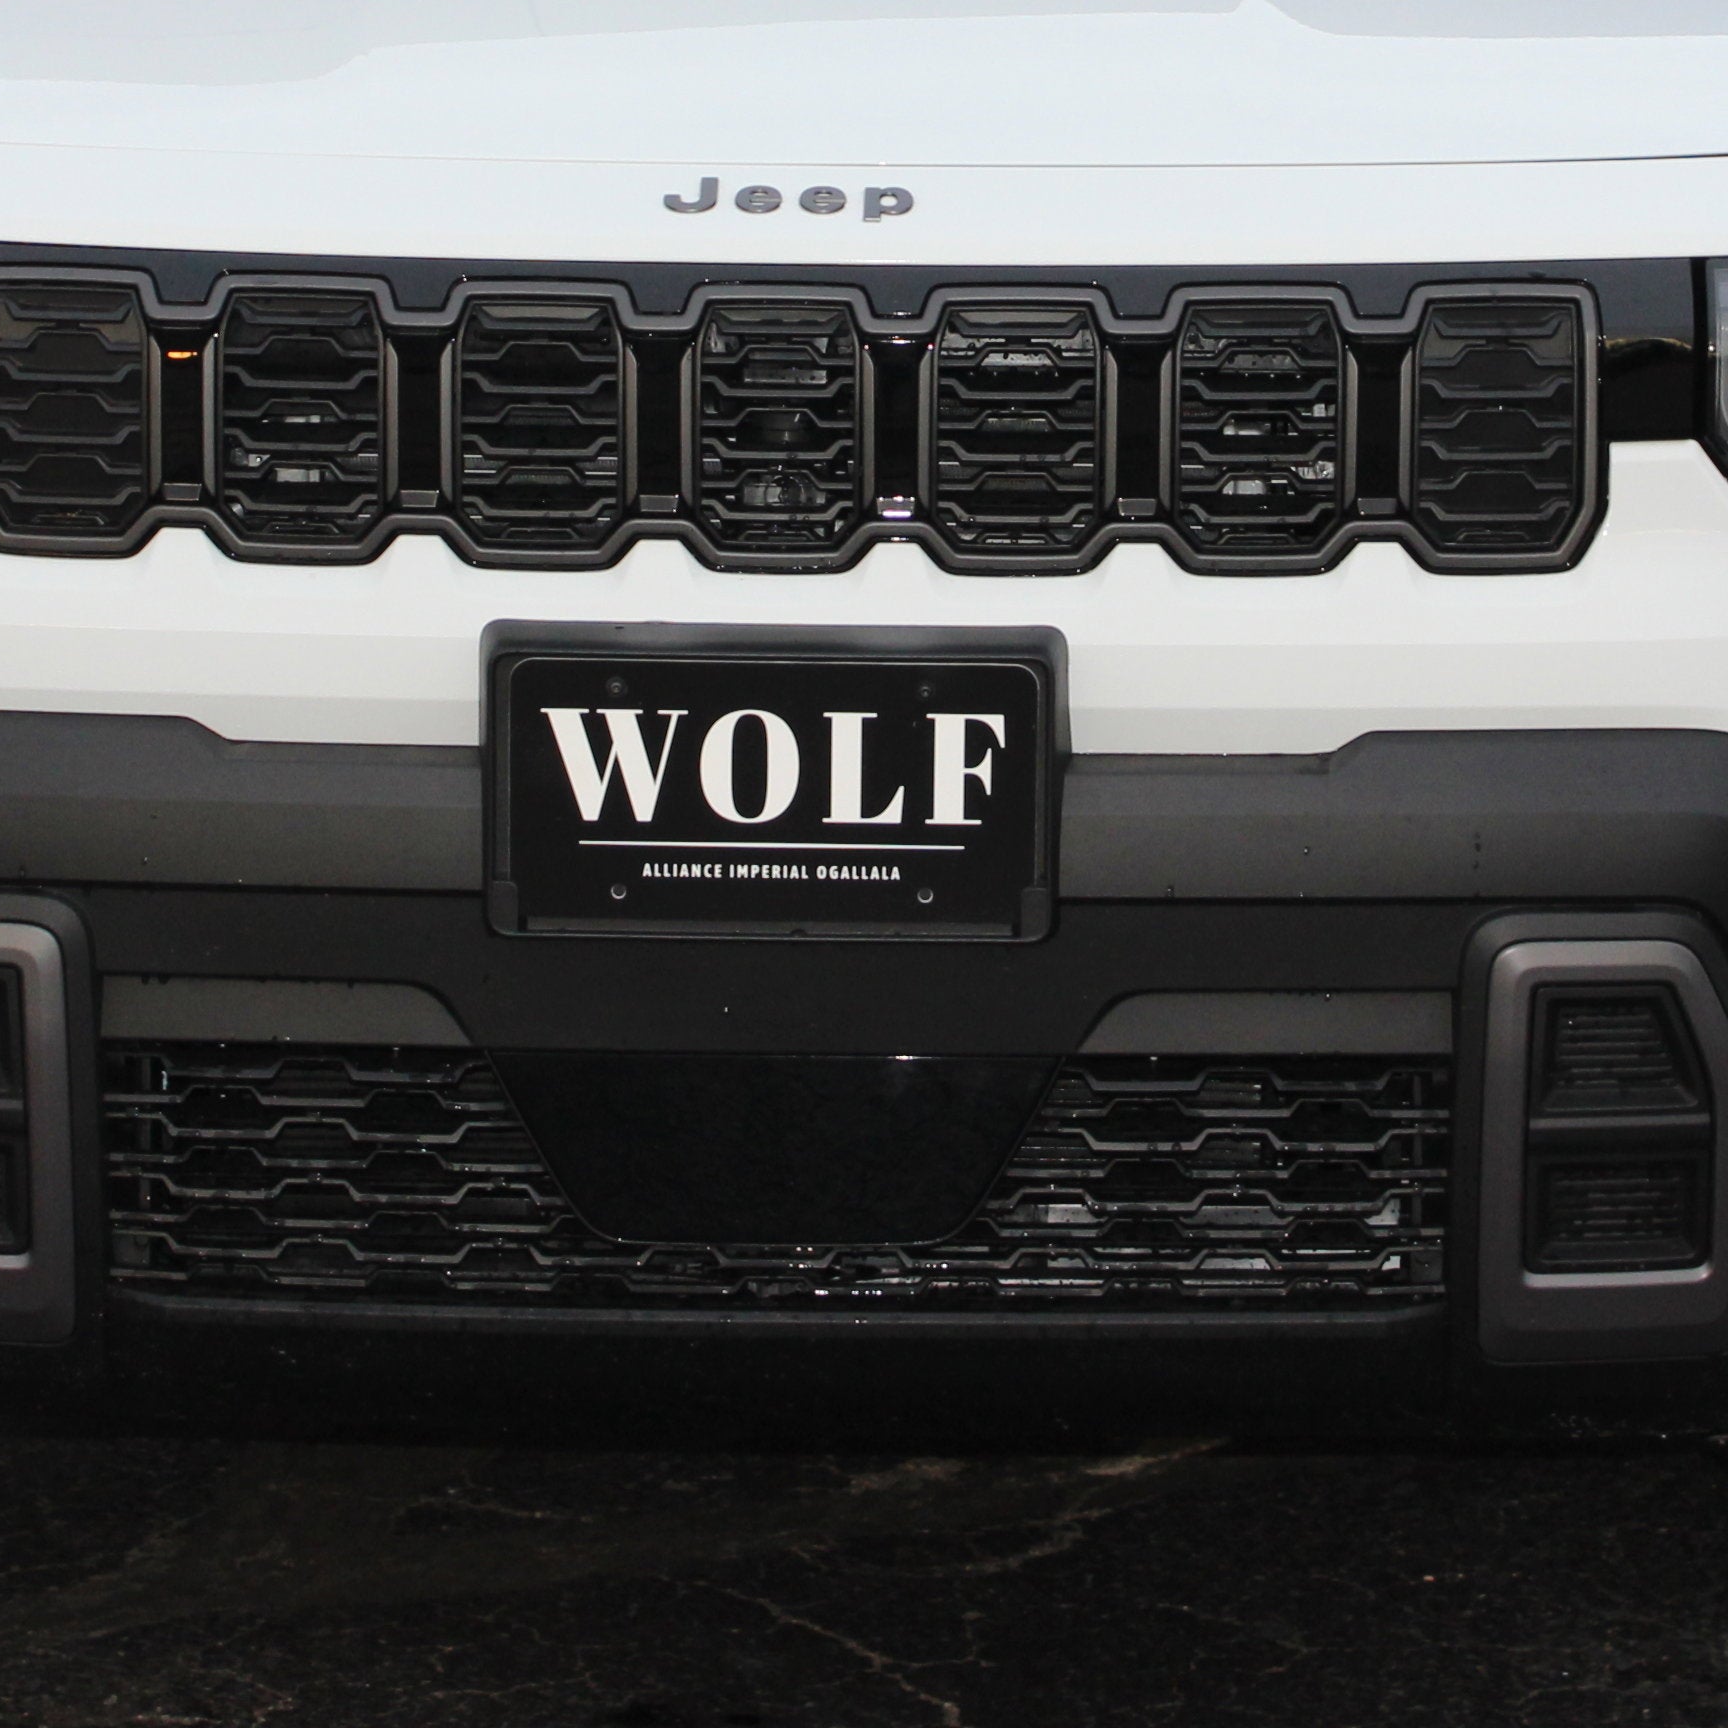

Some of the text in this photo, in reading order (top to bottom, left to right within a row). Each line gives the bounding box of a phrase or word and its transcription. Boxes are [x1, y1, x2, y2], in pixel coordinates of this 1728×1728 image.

[662, 176, 915, 222] Jeep
[539, 707, 1006, 826] WOLF
[642, 862, 901, 881] ALLIANCE IMPERIAL OGALLALA
